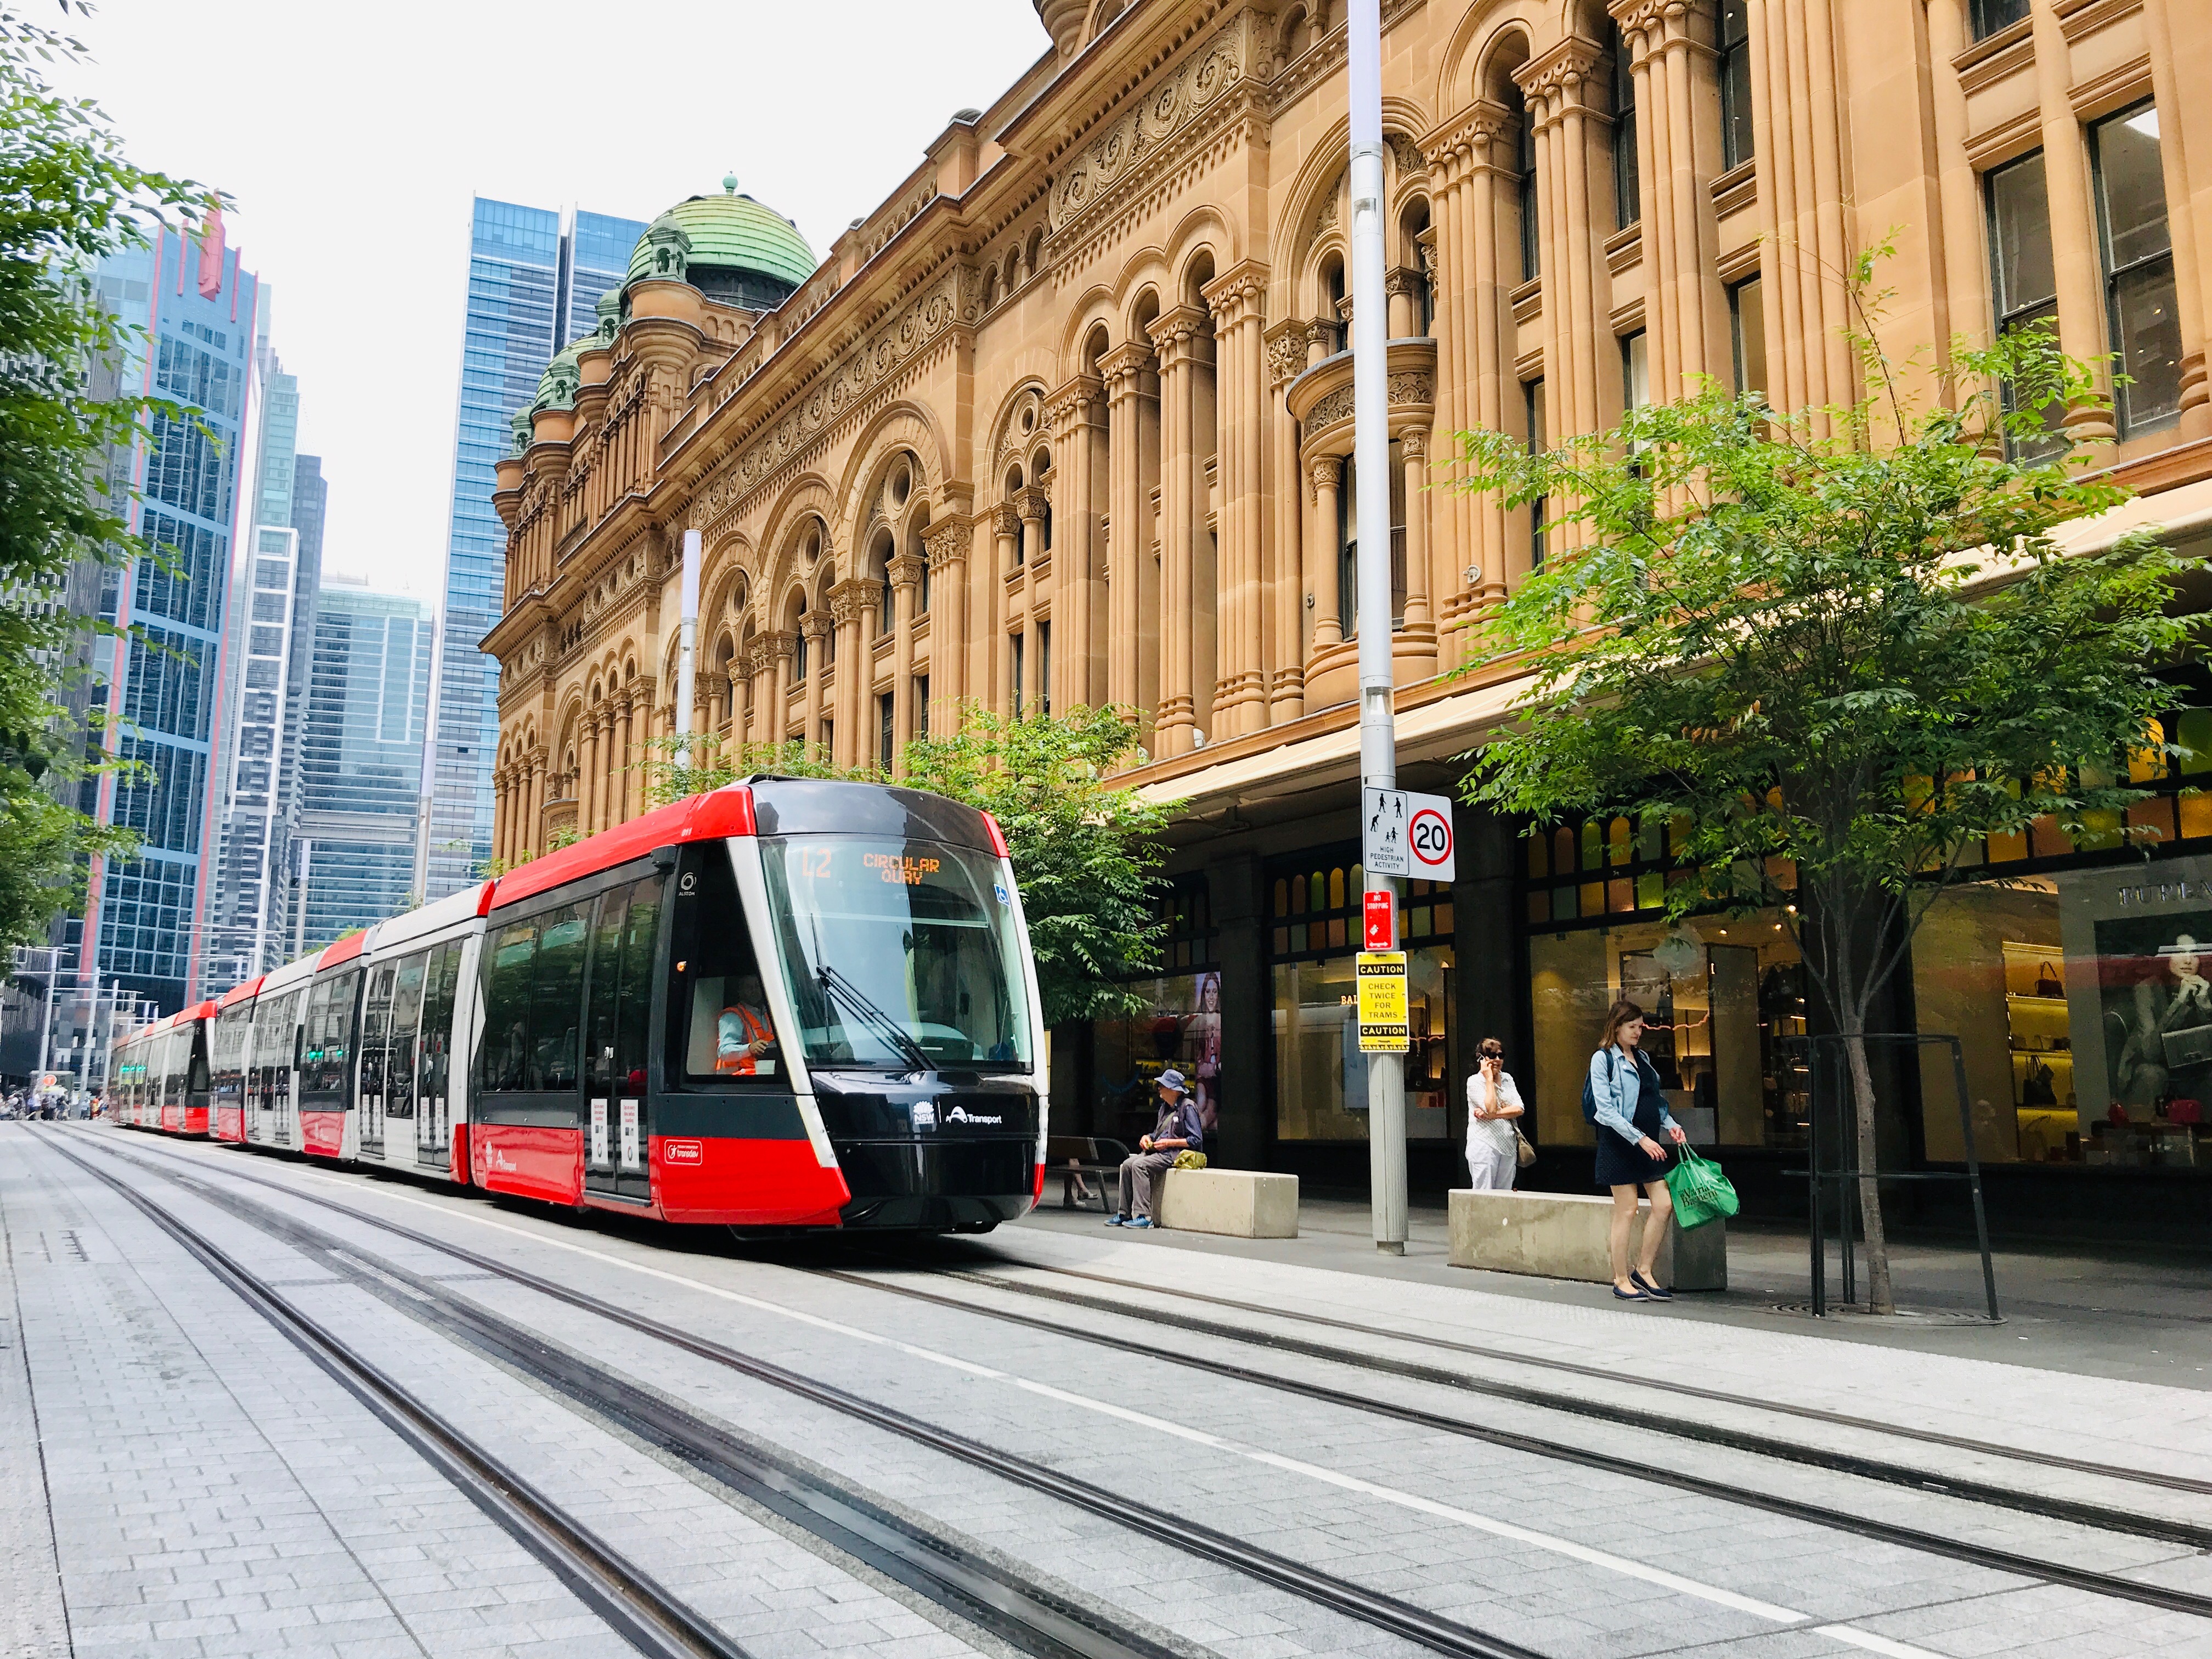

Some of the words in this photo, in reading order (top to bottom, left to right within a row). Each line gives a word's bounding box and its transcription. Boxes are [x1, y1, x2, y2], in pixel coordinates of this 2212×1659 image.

[1417, 823, 1445, 851] 20
[802, 846, 831, 878] L2
[1370, 853, 1404, 862] PEDESTRIAN
[864, 853, 940, 873] CIRCULAR
[1374, 861, 1400, 870] ACTIVITY
[881, 869, 923, 885] QUAY
[1360, 966, 1403, 974] CAUTION
[1362, 1026, 1405, 1035] CAUTION
[914, 1113, 934, 1122] NSW
[967, 1114, 1002, 1125] Transport
